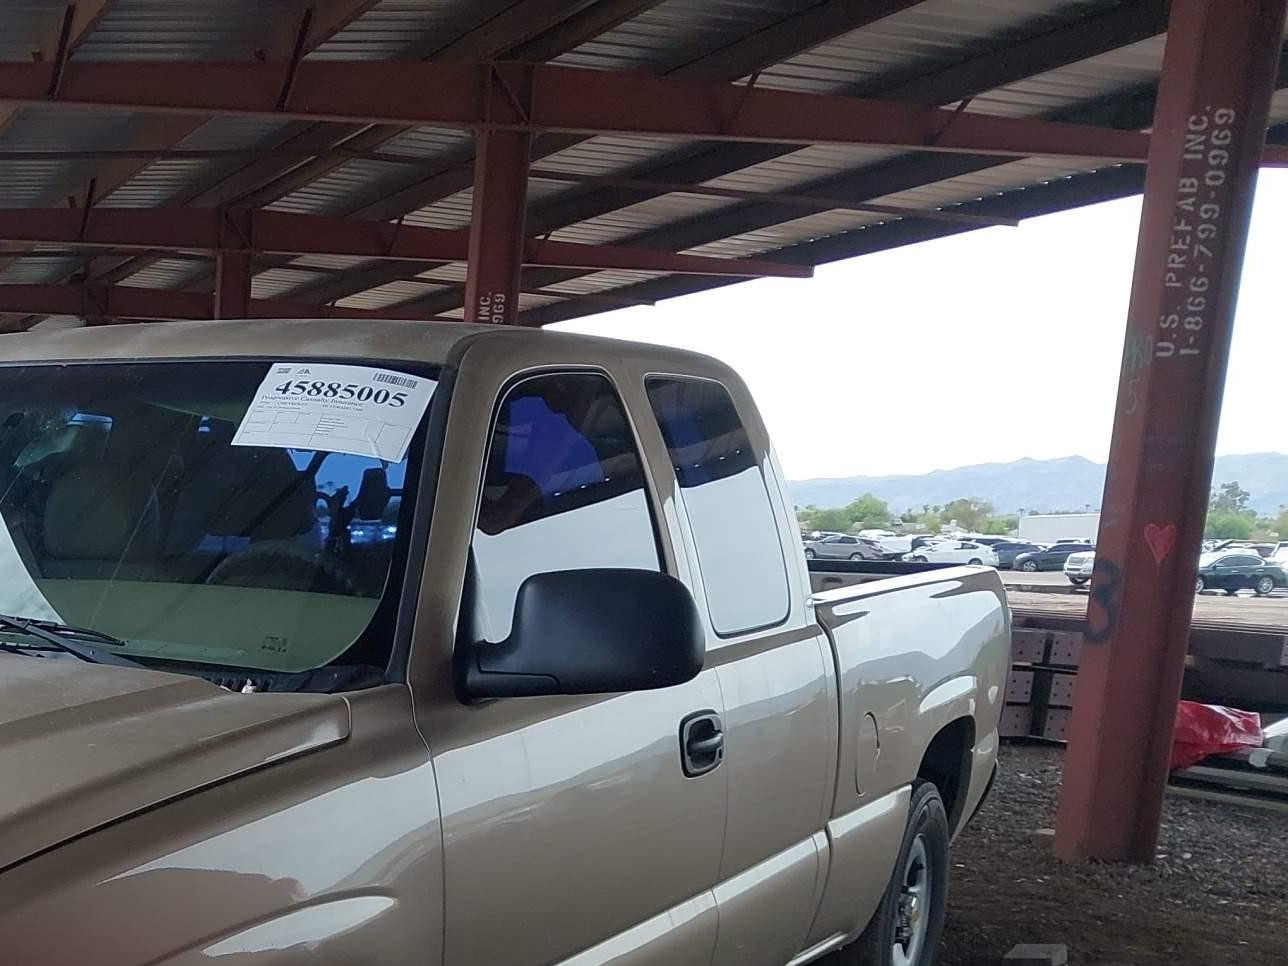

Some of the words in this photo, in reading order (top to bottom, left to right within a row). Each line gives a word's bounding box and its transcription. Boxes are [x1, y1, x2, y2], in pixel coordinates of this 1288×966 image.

[1184, 105, 1211, 160] INC.
[1165, 177, 1199, 287] PREFAB
[1179, 108, 1236, 355] 1-866-799-0969
[477, 291, 492, 320] INC.
[1156, 305, 1180, 357] U.S.
[275, 379, 409, 408] 45885005
